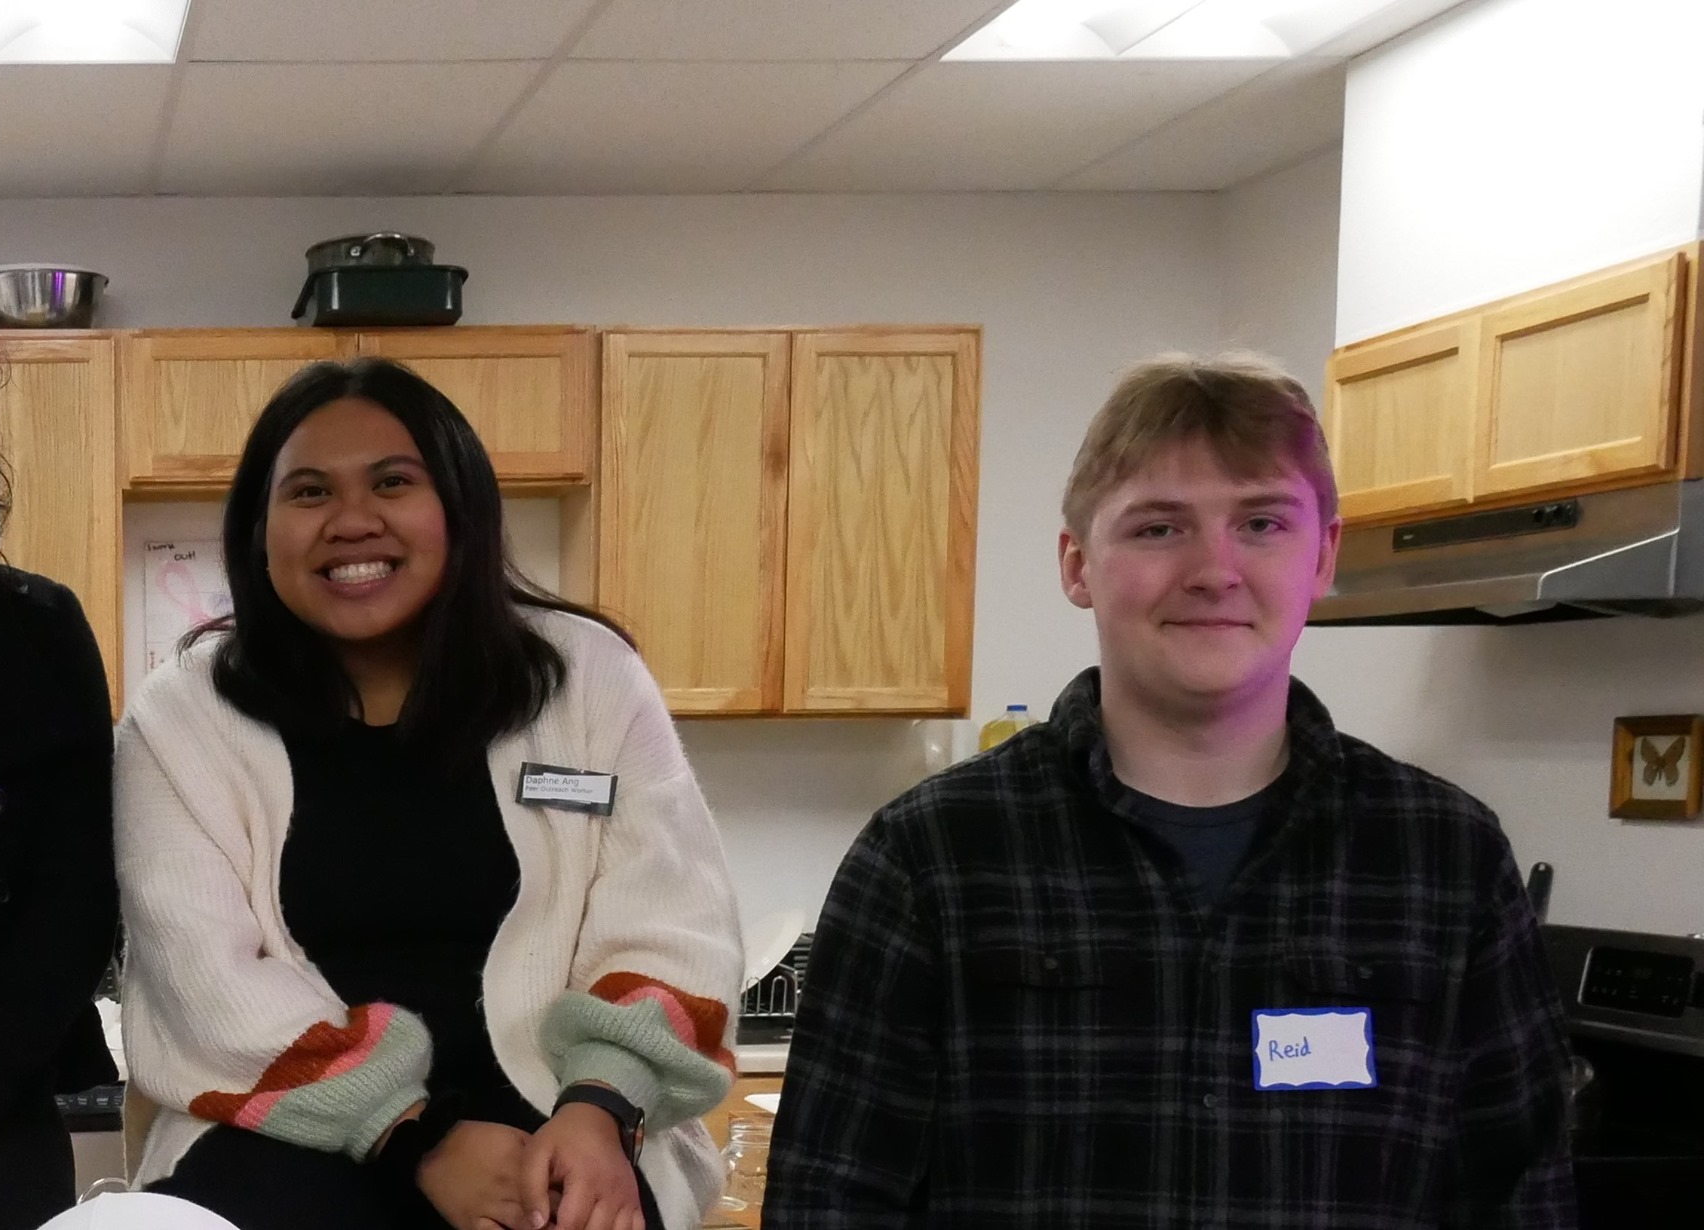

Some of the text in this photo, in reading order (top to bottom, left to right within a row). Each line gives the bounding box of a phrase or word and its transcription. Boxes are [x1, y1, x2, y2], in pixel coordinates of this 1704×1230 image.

[526, 776, 579, 787] Daphne Ang
[1269, 1036, 1311, 1061] Reid
